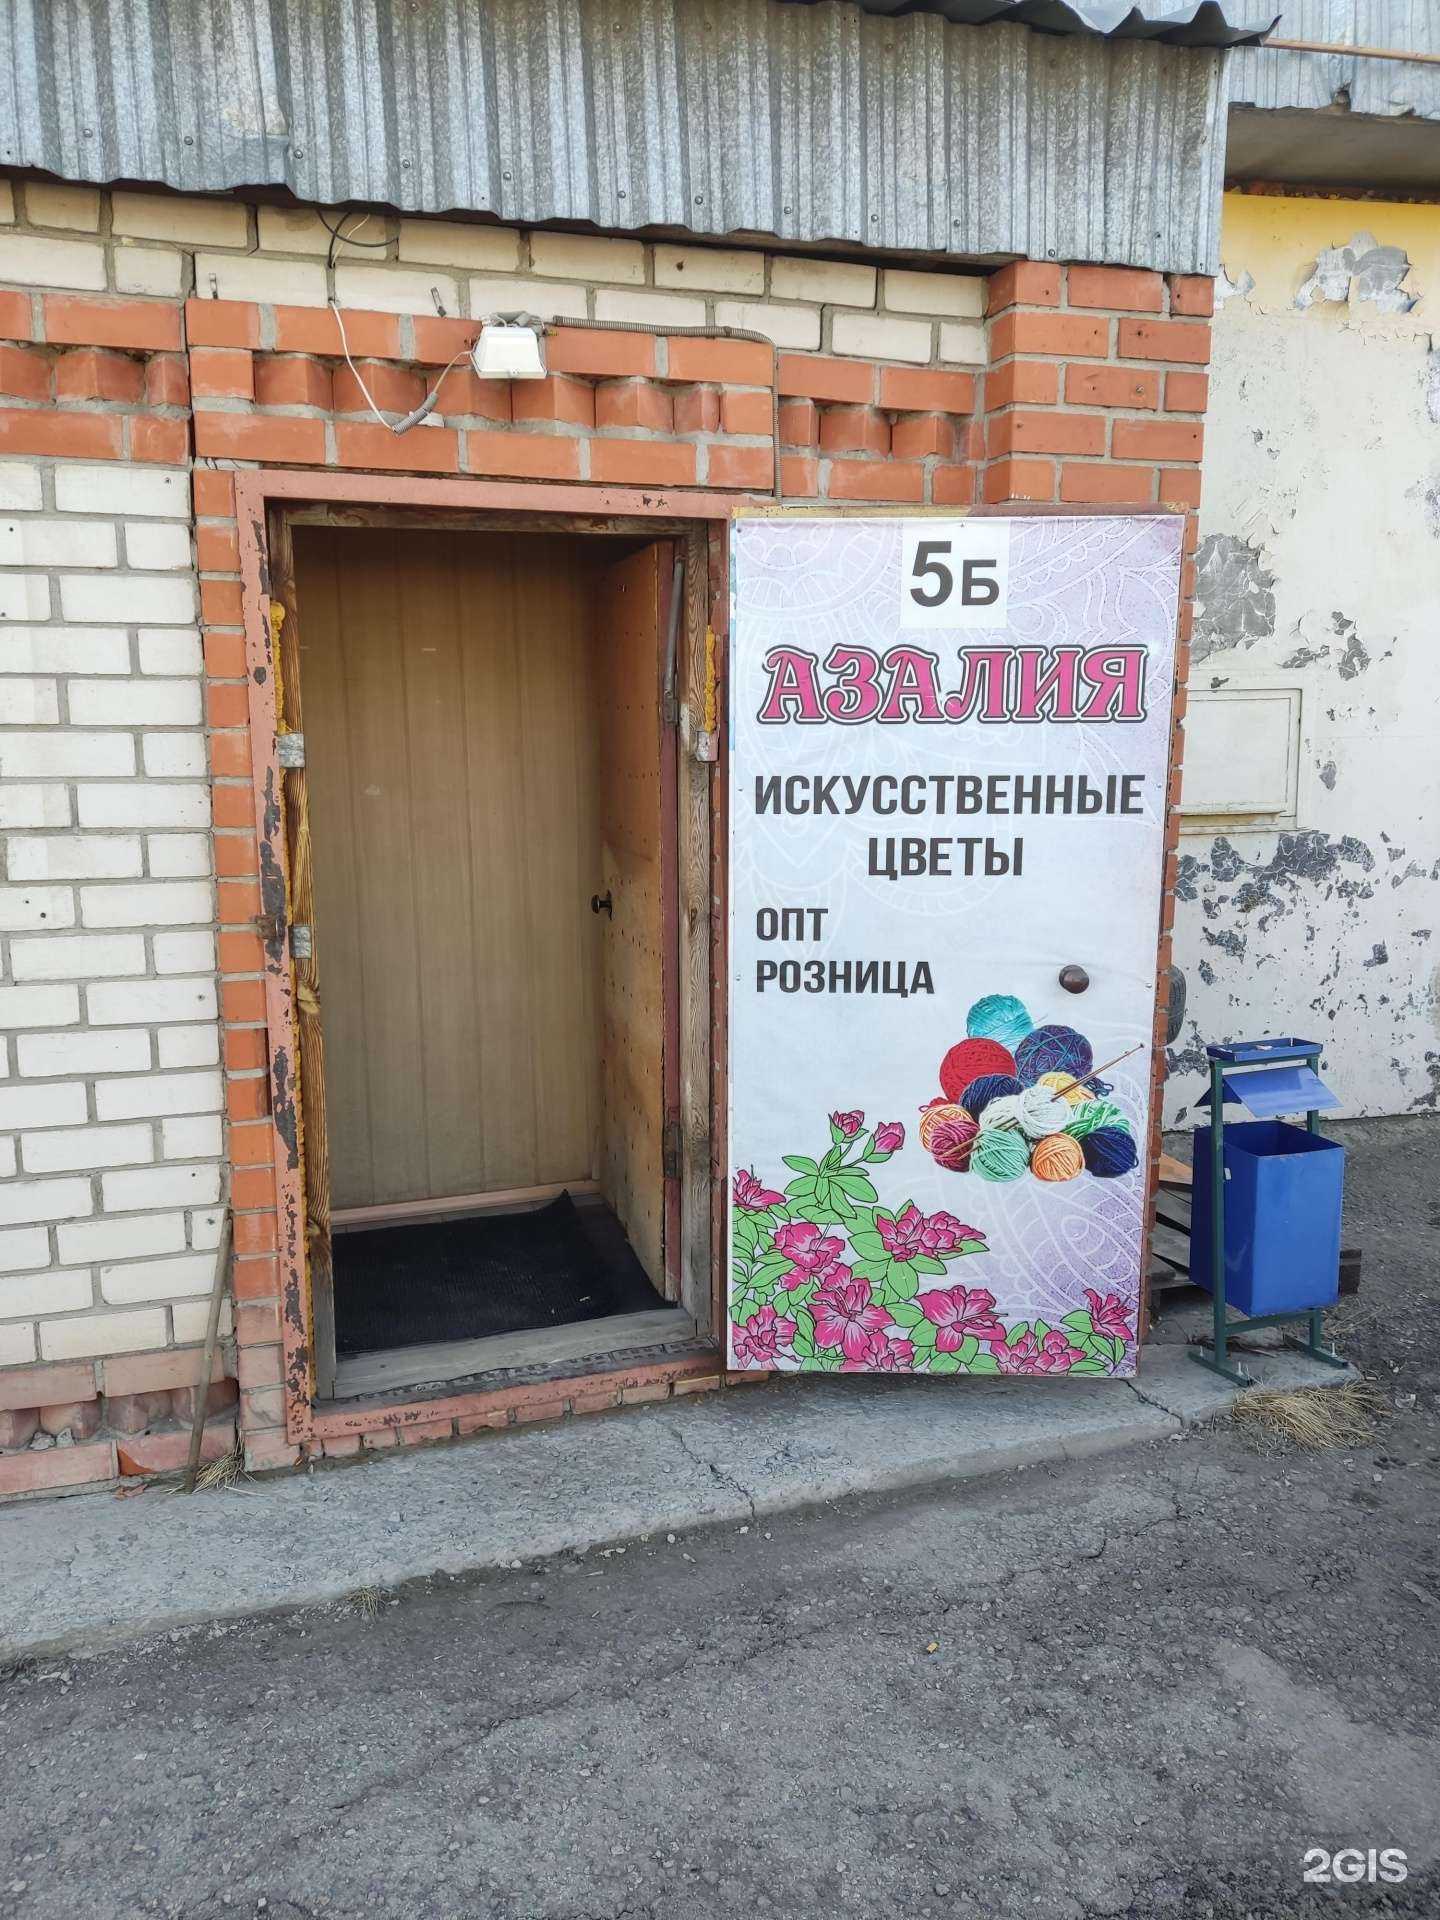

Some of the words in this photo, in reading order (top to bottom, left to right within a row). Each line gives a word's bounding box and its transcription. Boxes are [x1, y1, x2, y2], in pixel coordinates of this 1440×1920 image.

[909, 540, 1000, 607] 5Б
[756, 643, 1148, 726] АЗАЛИЯ
[754, 774, 1146, 815] ИСКУССТВЕННЫЕ
[867, 837, 1024, 881] ЦВЕТЫ
[755, 907, 829, 942] ОПТ
[755, 959, 935, 998] РОЗНИЦА
